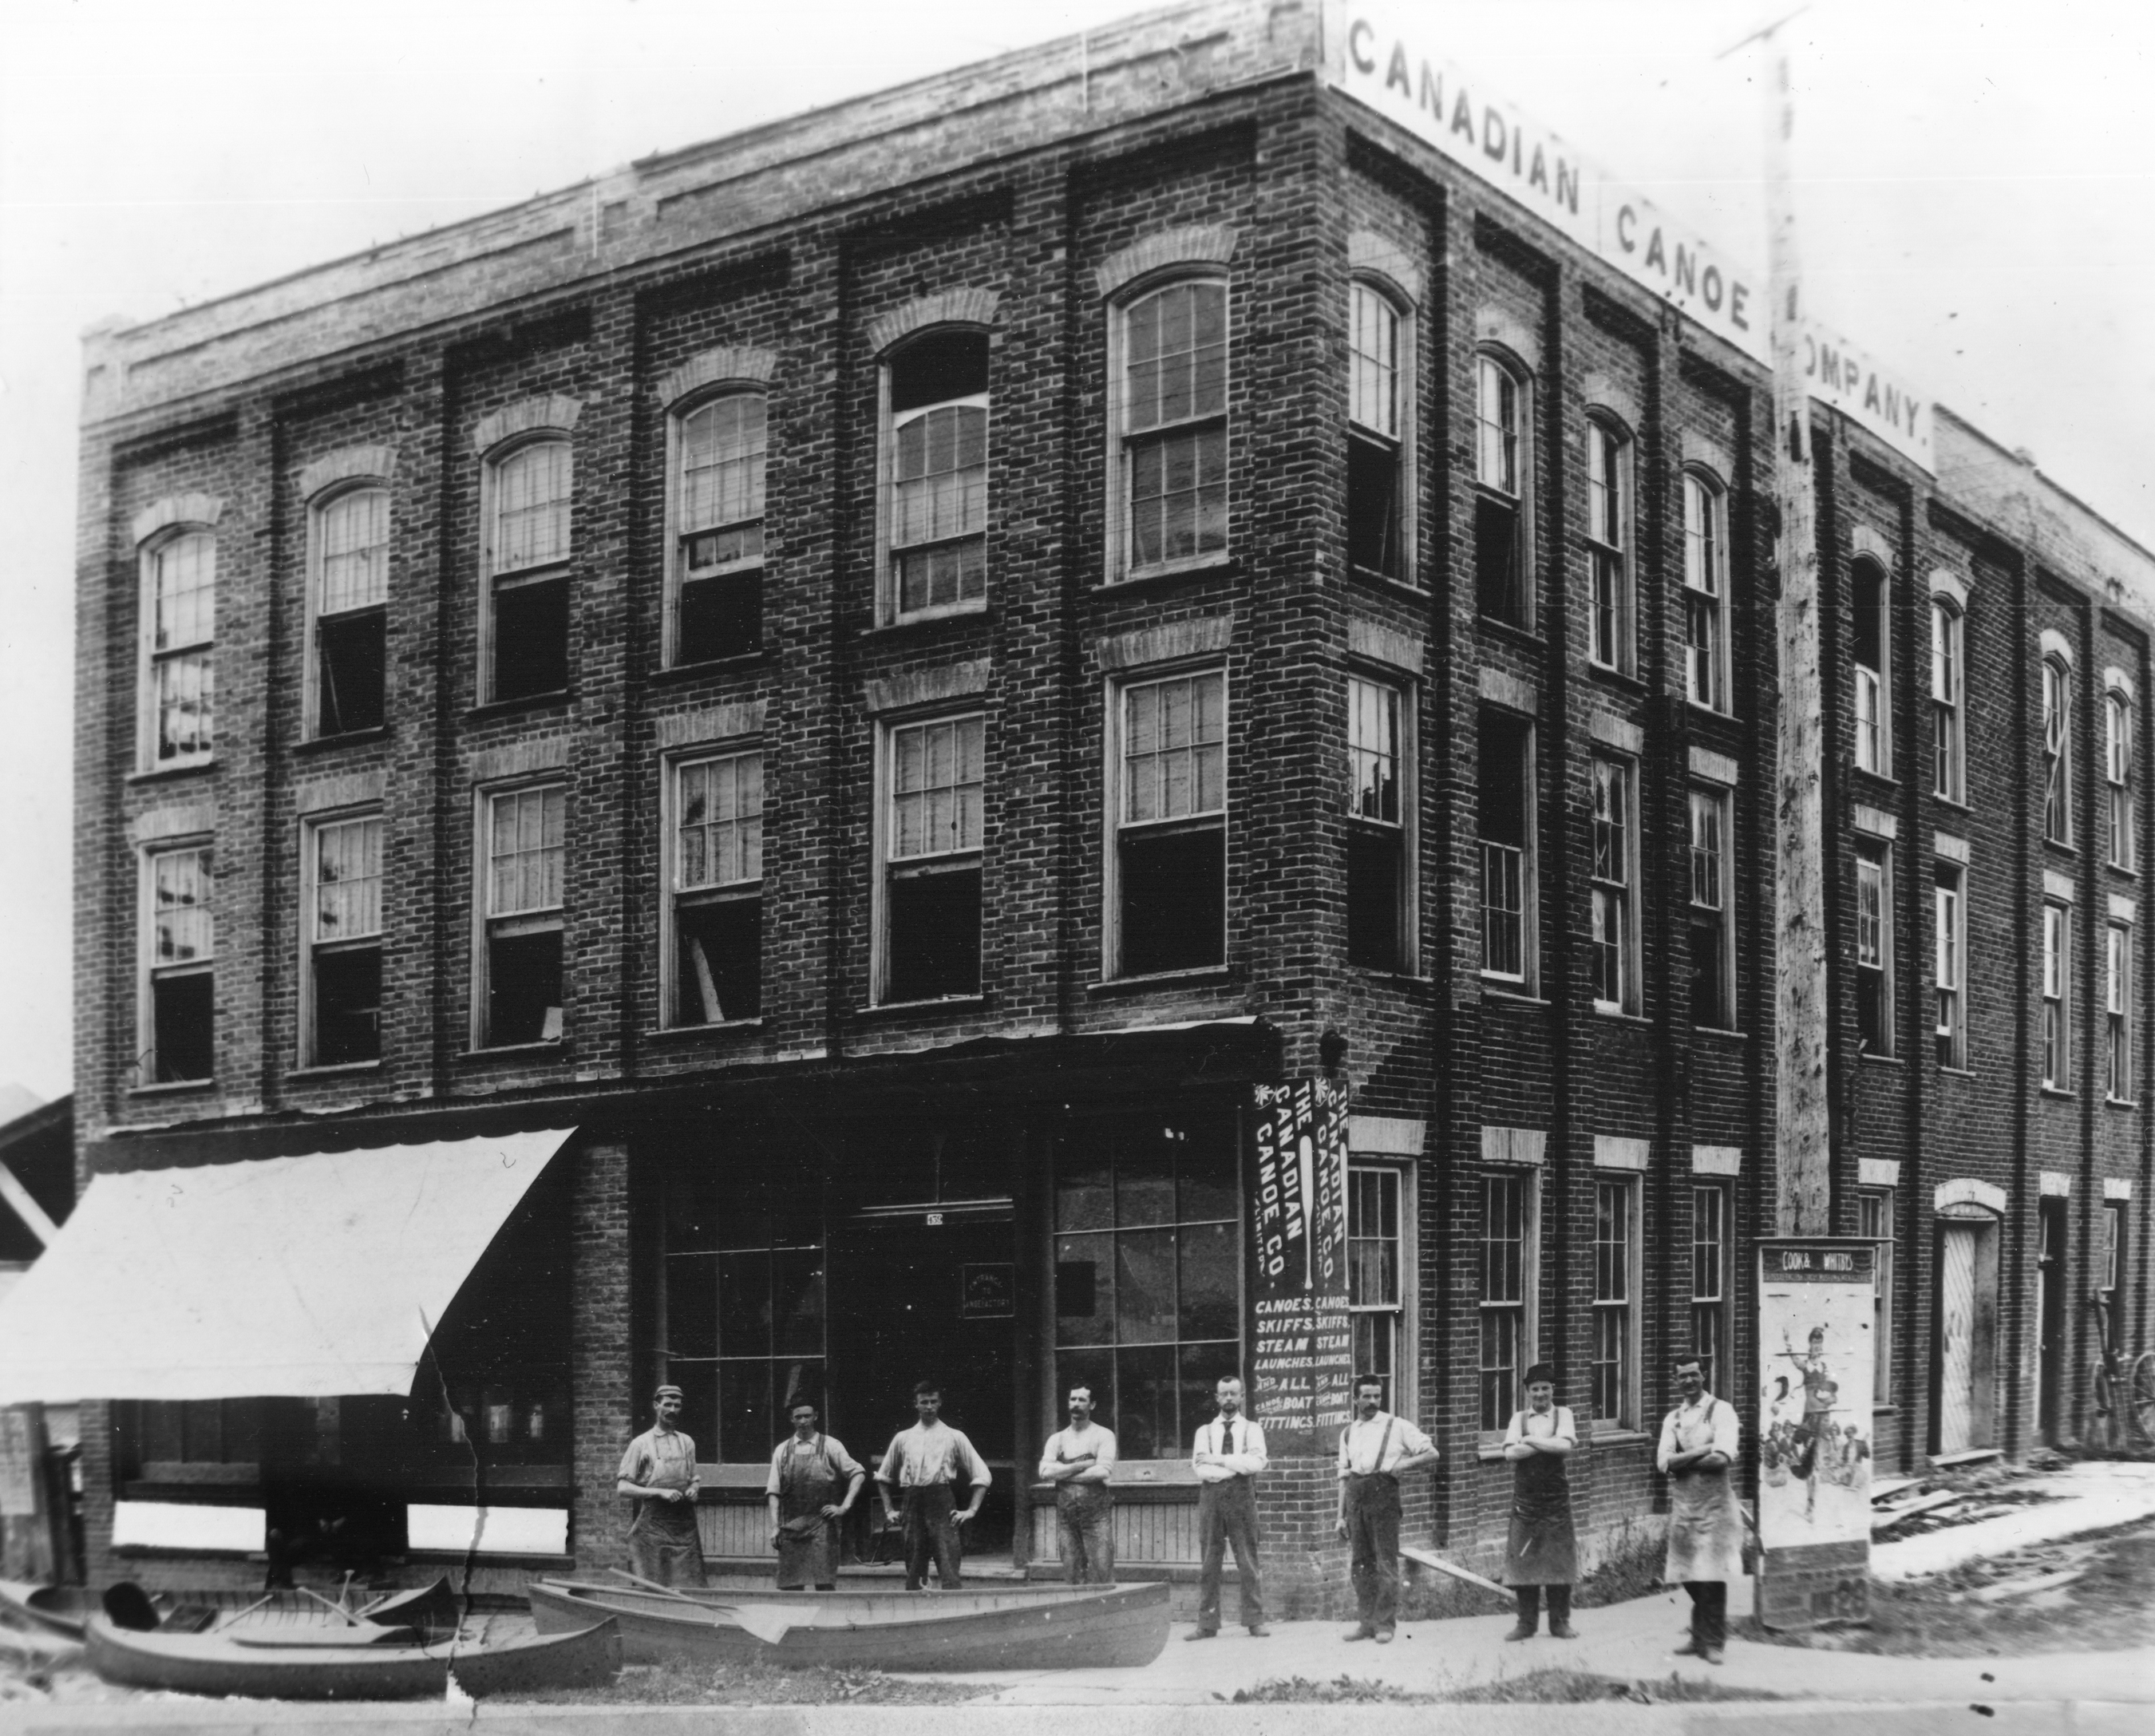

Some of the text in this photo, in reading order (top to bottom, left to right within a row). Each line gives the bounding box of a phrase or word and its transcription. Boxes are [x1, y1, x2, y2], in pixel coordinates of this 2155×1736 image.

[1349, 18, 1927, 445] CANADIAN CANOE OMPANY.
[1295, 1080, 1312, 1131] THE
[1338, 1084, 1349, 1134] THE
[1256, 1122, 1279, 1224] CANOE
[1276, 1084, 1303, 1241] CANADIAN
[1318, 1124, 1331, 1227] CANOE
[1327, 1089, 1343, 1246] CANADIAN
[1256, 1338, 1309, 1353] STEAM
[1317, 1334, 1350, 1350] STEAM
[1279, 1377, 1311, 1390] ALL
[1283, 1396, 1315, 1410] BOAT
[1331, 1373, 1349, 1386] ALL
[1331, 1391, 1350, 1405] BOAT
